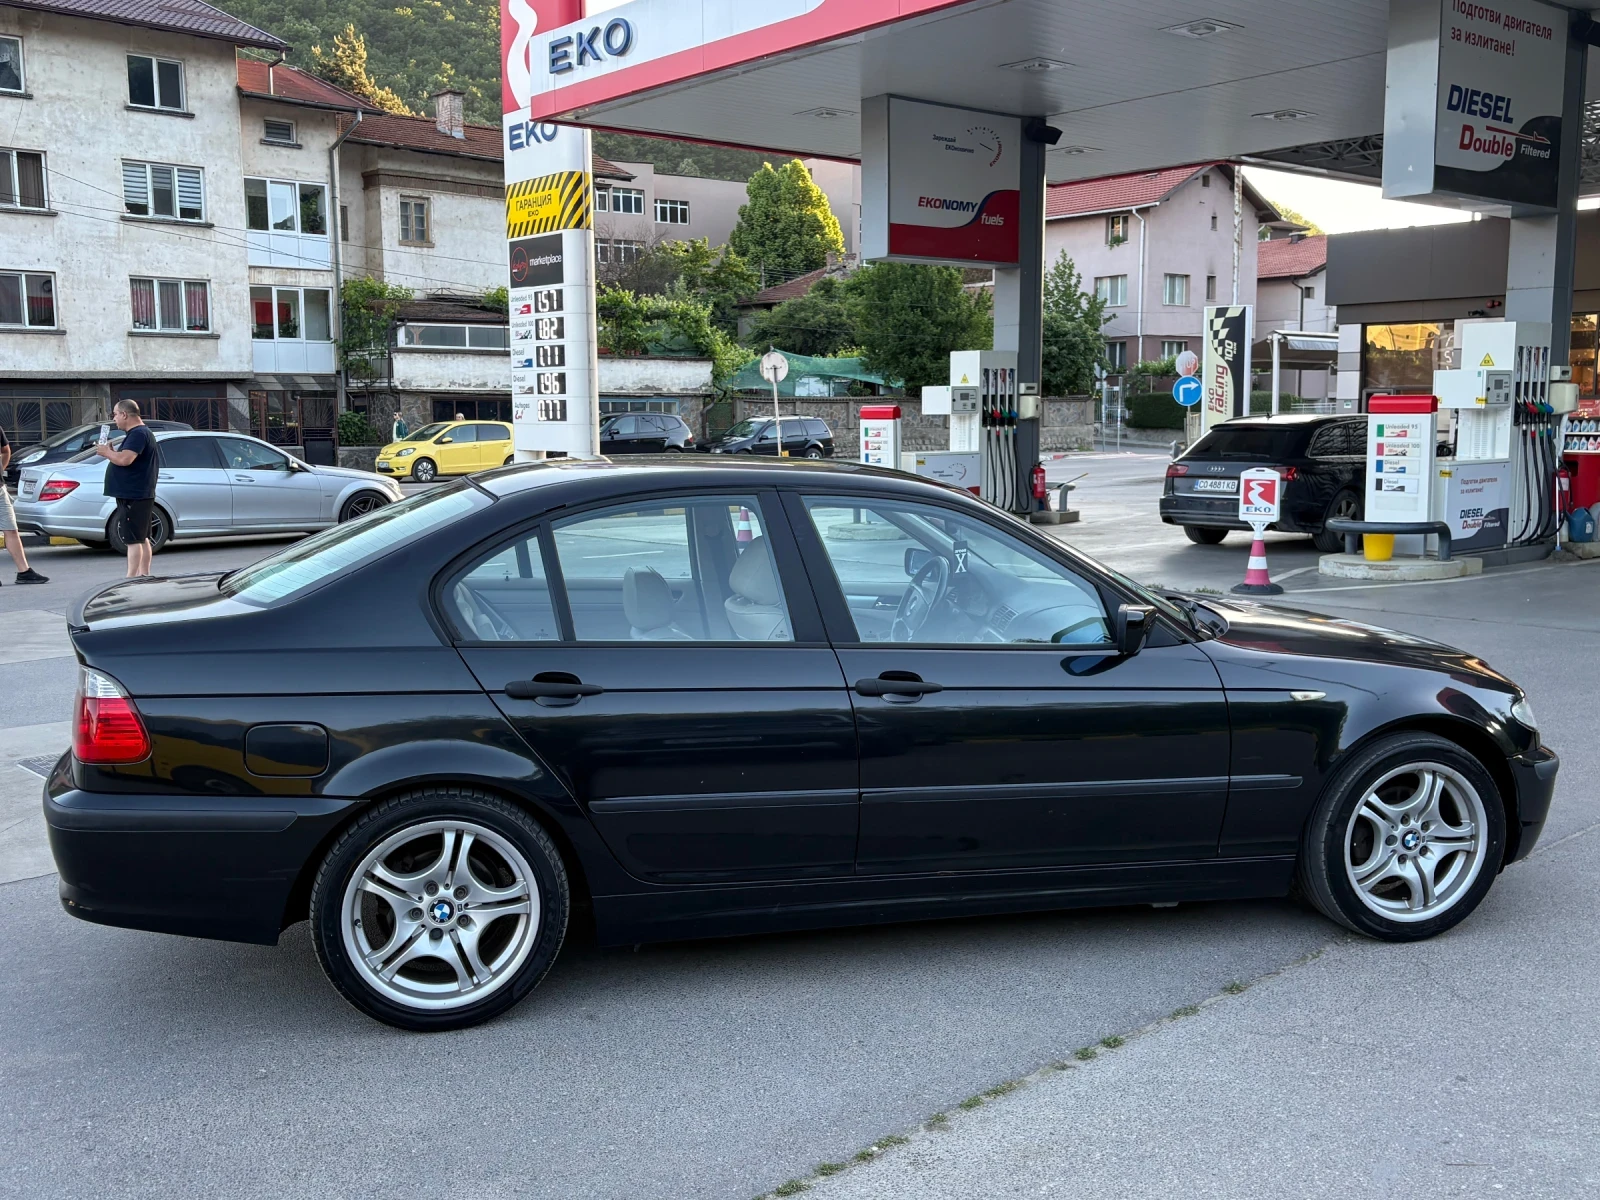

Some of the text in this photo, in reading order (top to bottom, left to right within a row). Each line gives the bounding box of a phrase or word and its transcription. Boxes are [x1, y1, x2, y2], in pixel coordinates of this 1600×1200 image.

[1452, 0, 1552, 41] Подготви двигателя
[549, 17, 633, 75] EKO
[1451, 26, 1516, 57] за излитане!
[1446, 84, 1514, 124] DIESEL
[509, 121, 558, 151] EKO
[1459, 124, 1551, 159] Double Filtered
[515, 194, 552, 211] ГАРАНЦИЯ
[918, 196, 1004, 226] EKONOMY fuels
[527, 209, 540, 218] EKO
[529, 254, 562, 266] marketplace
[512, 347, 525, 356] Diesel
[1224, 340, 1233, 361] 100
[513, 374, 526, 383] Diesel
[1214, 364, 1229, 414] racing
[514, 402, 530, 411] Autogas
[1460, 507, 1484, 519] DIESEL
[1462, 520, 1482, 530] Double
